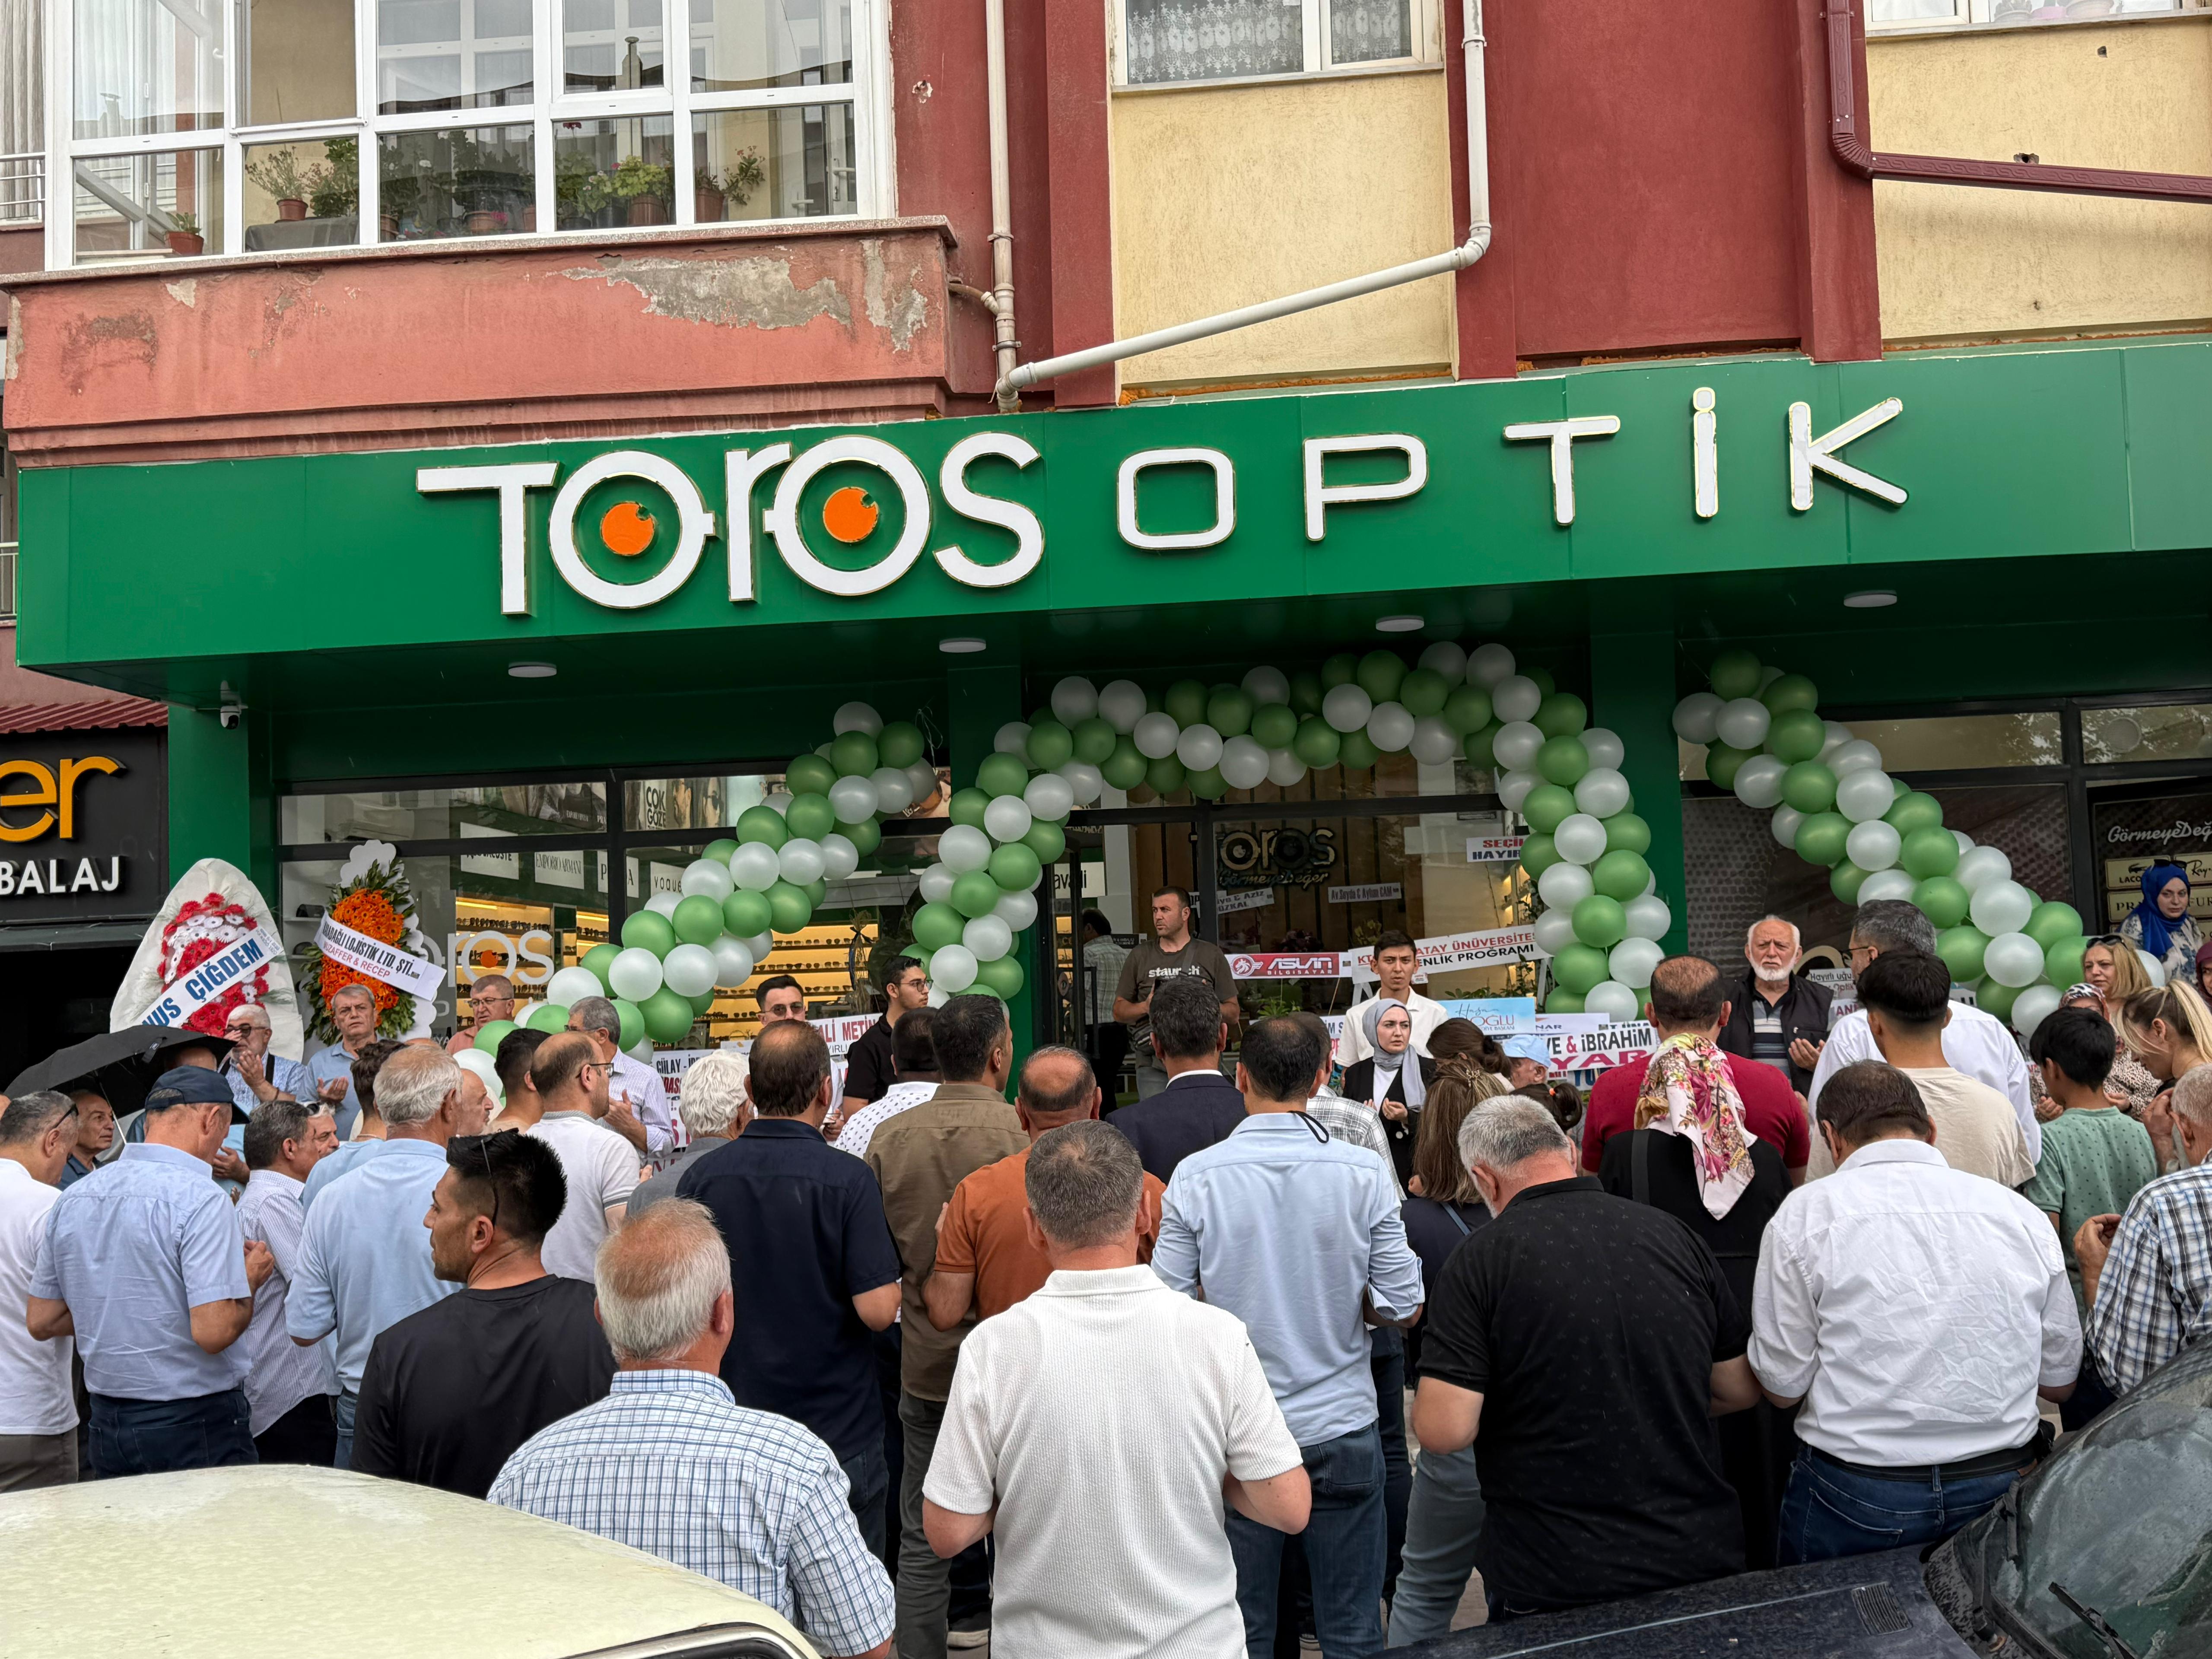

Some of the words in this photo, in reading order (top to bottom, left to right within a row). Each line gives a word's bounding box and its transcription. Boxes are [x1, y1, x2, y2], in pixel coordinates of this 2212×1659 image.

[1116, 386, 1910, 550] OPTİK
[0, 856, 120, 896] BALAJ
[353, 957, 359, 966] &
[360, 960, 390, 978] RECEP
[1458, 944, 1534, 961] PROĞRAMI
[185, 938, 264, 1003] ÇİĞDEM
[1566, 1035, 1578, 1054] &
